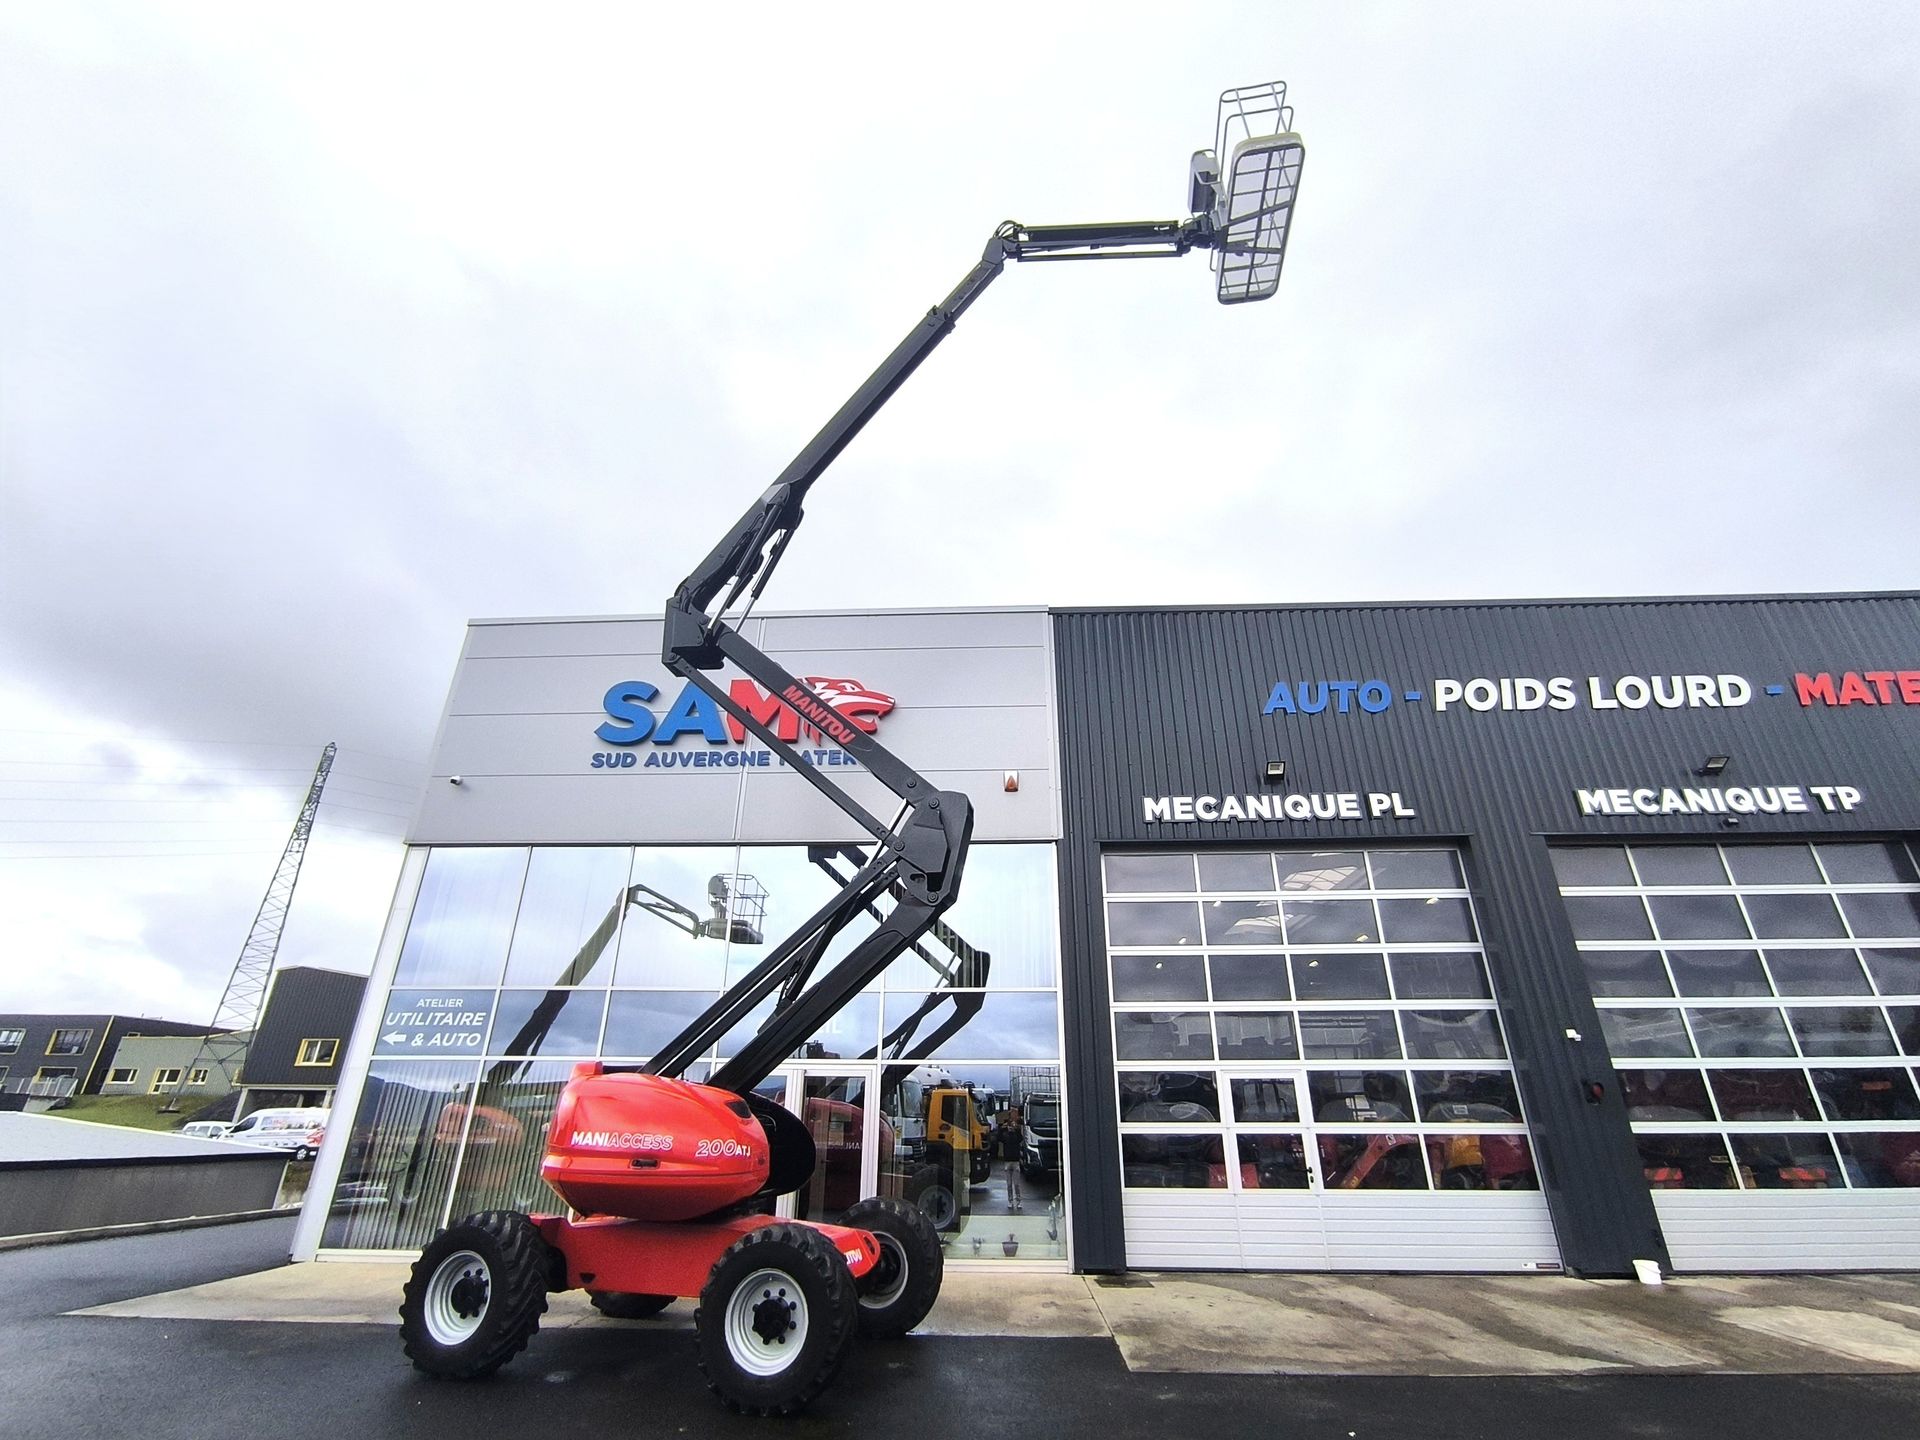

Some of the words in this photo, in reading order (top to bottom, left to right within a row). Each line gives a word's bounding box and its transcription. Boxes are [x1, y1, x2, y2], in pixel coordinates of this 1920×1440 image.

[1262, 680, 1392, 714] AUTO
[1434, 676, 1576, 712] POIDS
[1588, 674, 1752, 709] LOURD
[594, 679, 799, 746] SAM
[782, 685, 856, 745] MANITOU
[590, 751, 638, 768] SUD
[644, 751, 770, 768] AUVERGNE
[1143, 793, 1361, 821] MECANIQUE
[1369, 792, 1415, 818] PL
[1577, 786, 1808, 815] MECANIQUE
[1810, 786, 1862, 812] TP
[416, 998, 464, 1008] ATELIER
[386, 1012, 486, 1026] UTILITAIRE
[411, 1033, 424, 1047] &
[427, 1032, 482, 1047] AUTO
[571, 1131, 673, 1150] MANIACCESS
